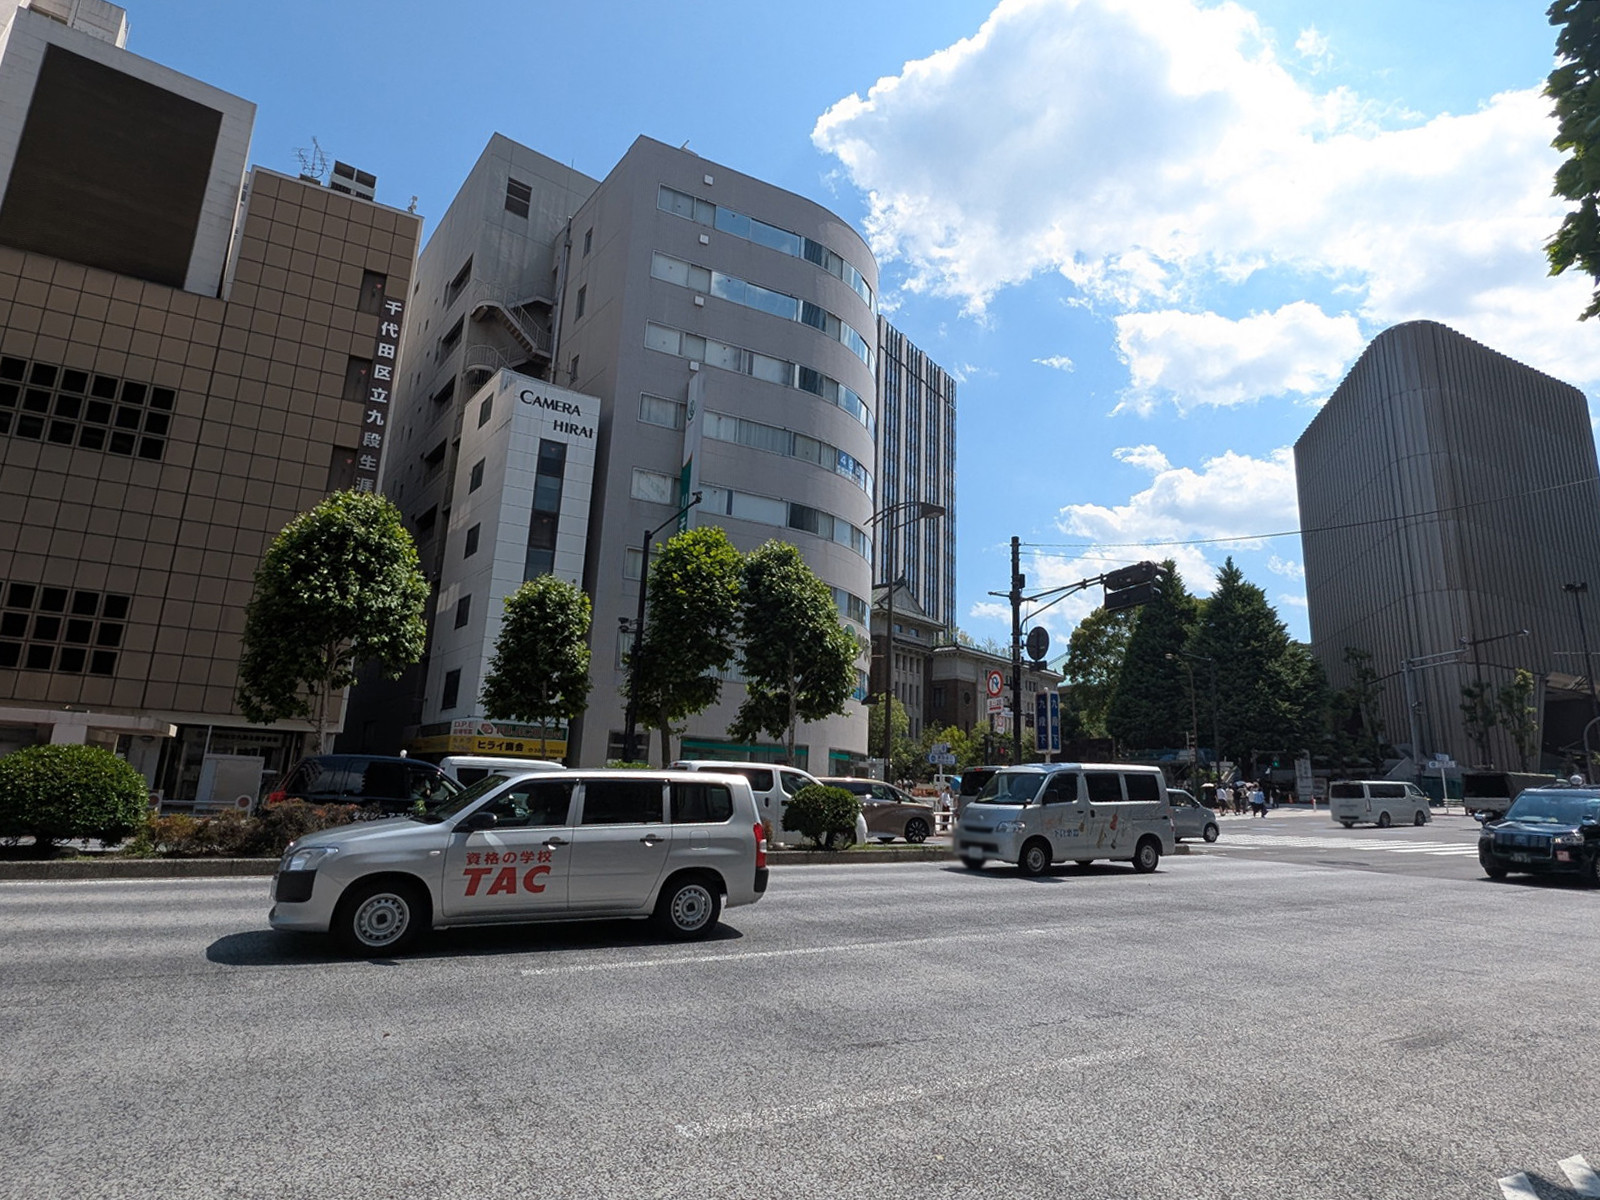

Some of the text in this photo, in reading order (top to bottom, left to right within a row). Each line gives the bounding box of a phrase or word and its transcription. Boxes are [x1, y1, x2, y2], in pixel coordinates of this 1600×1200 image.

[520, 390, 581, 417] CAMERA
[553, 419, 593, 439] HIRAI
[466, 850, 552, 865] 資格の学校
[463, 865, 551, 896] TAC
